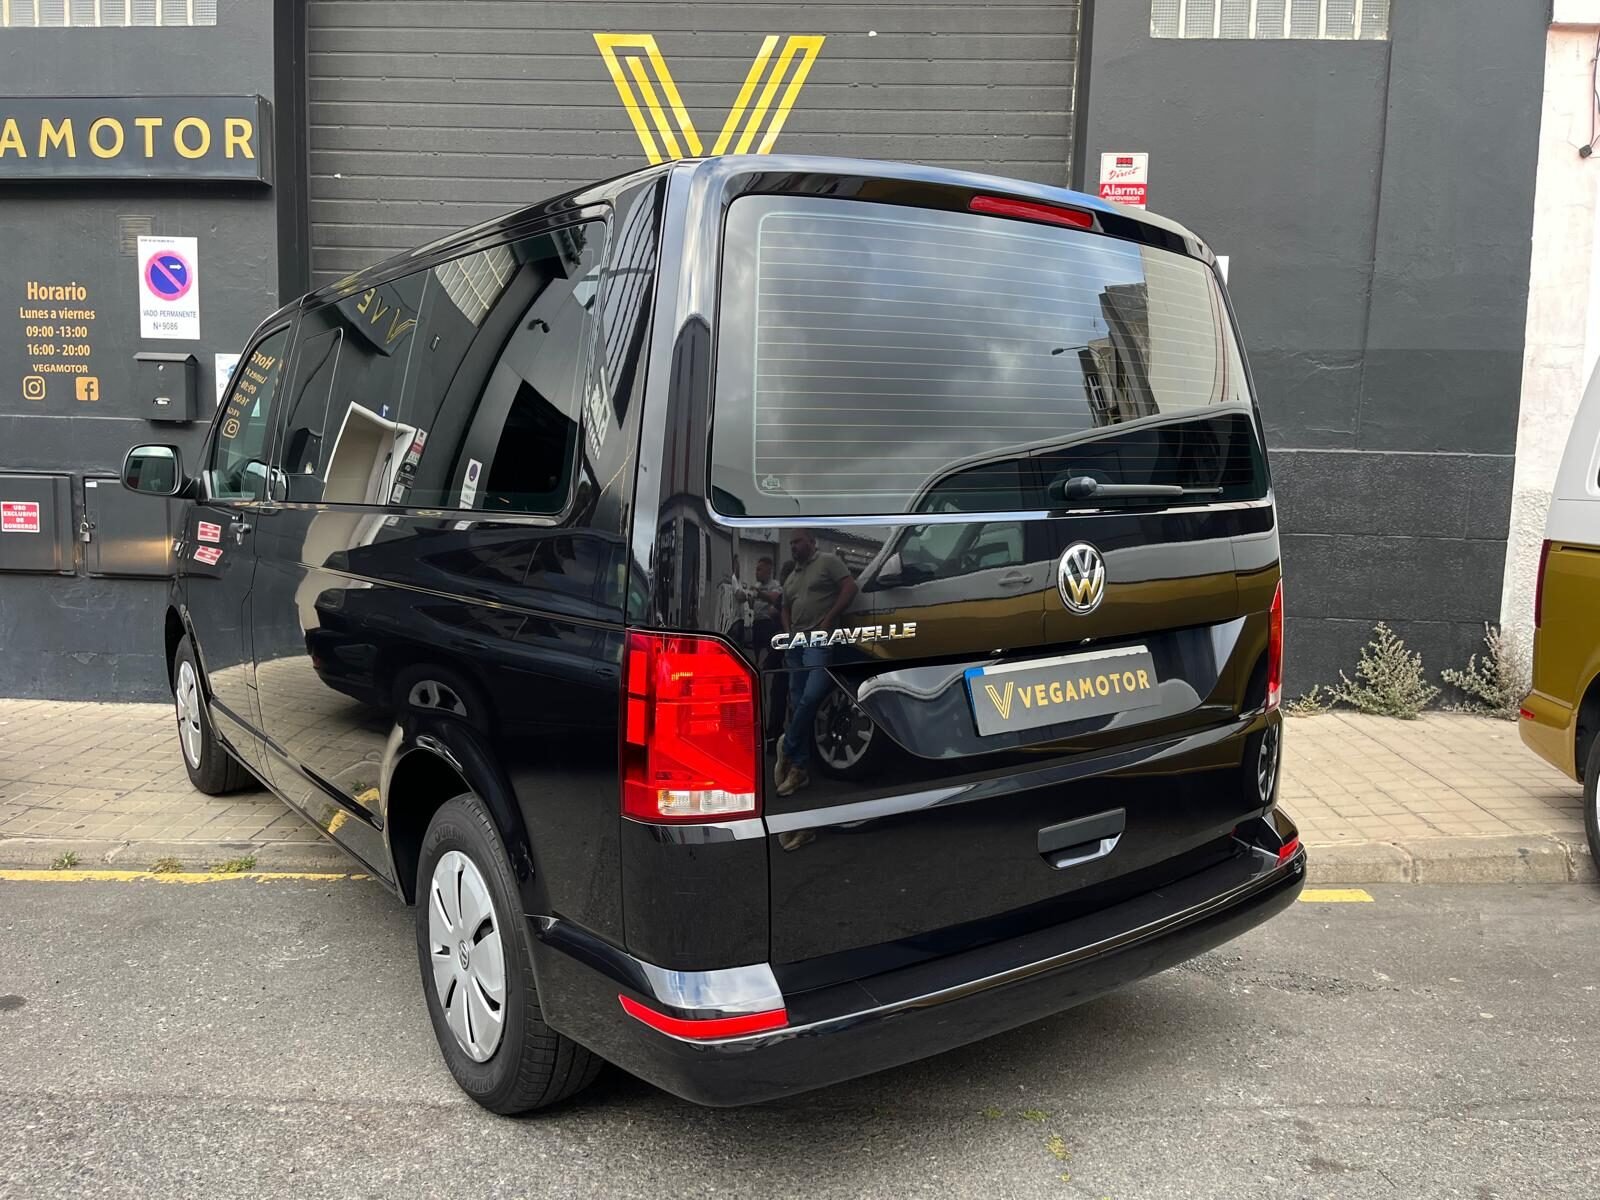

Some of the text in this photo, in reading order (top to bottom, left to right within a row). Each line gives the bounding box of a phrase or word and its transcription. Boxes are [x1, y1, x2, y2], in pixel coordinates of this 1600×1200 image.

[0, 117, 255, 159] AMOTOR
[1102, 184, 1144, 196] Alarma
[27, 281, 87, 300] Horario
[19, 306, 96, 320] Lunes a viernes
[26, 326, 54, 337] 09:00
[27, 344, 54, 355] 16:00
[62, 344, 91, 356] 20:00
[33, 364, 88, 373] VEGAMOTOR
[770, 622, 917, 650] CARAVELLE
[1017, 669, 1151, 709] VEGAMOTOR
